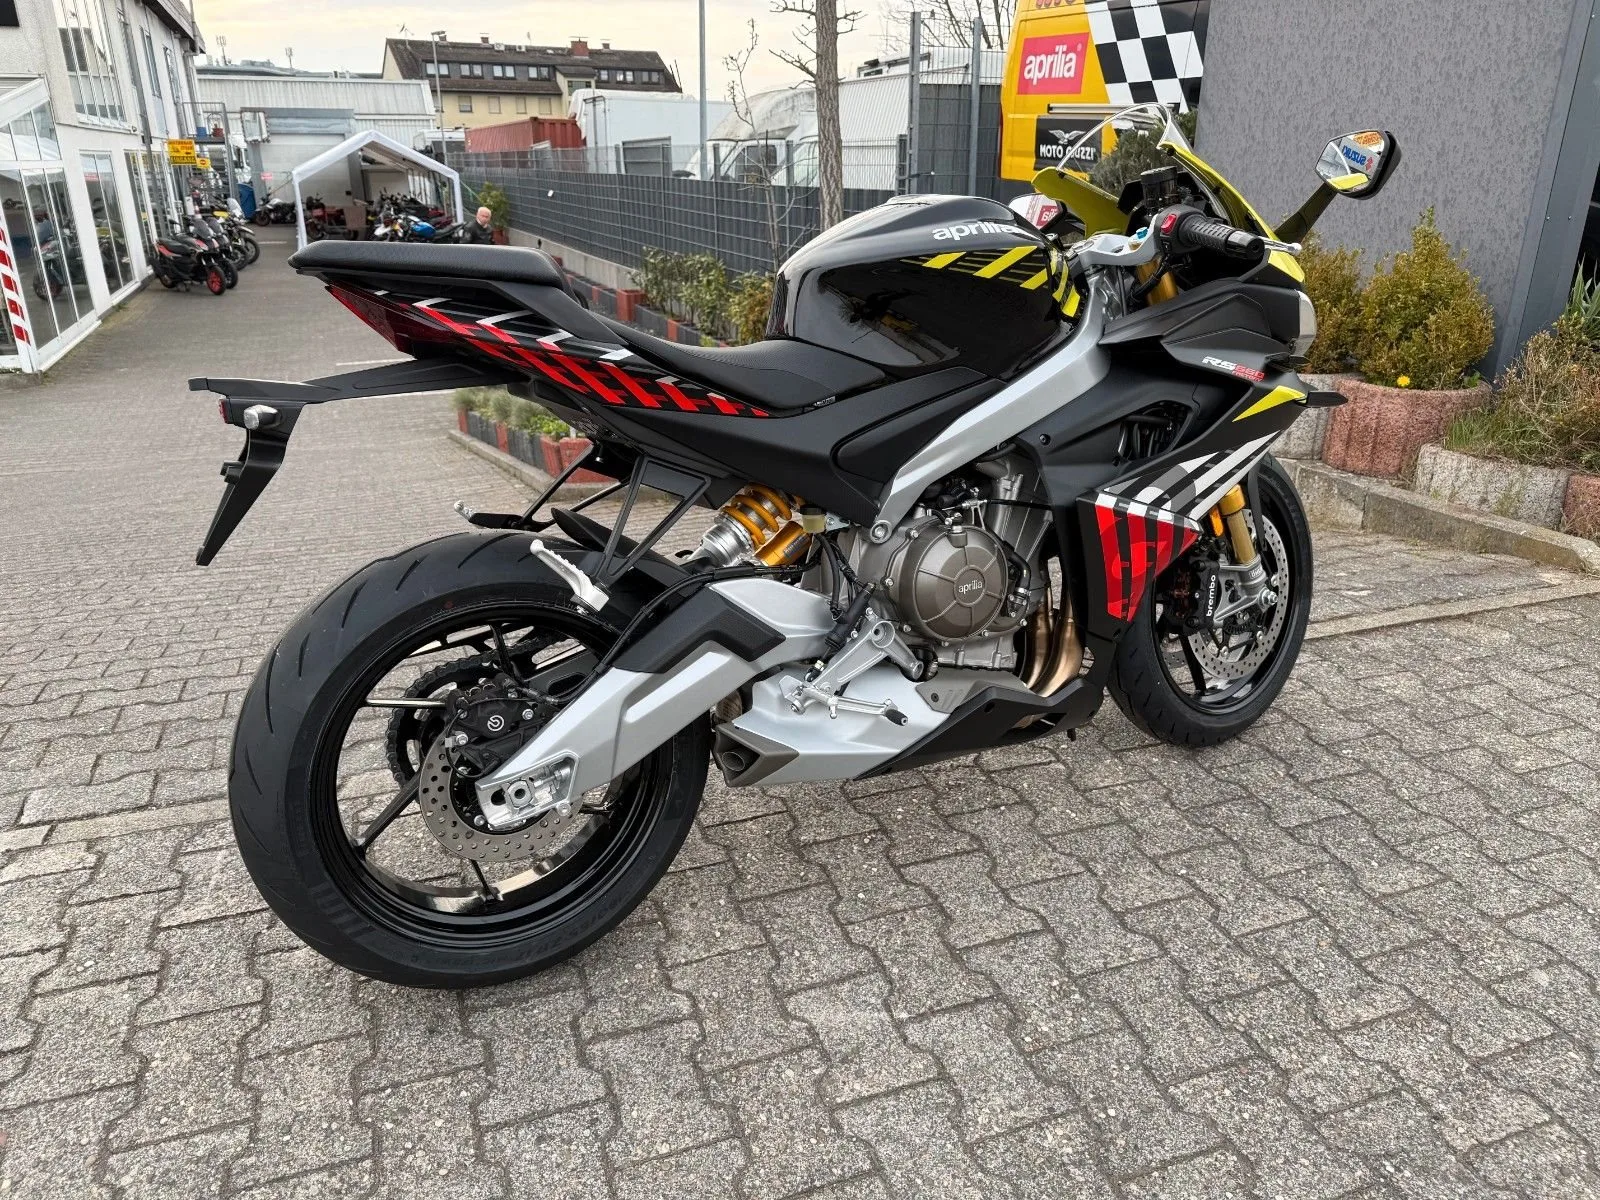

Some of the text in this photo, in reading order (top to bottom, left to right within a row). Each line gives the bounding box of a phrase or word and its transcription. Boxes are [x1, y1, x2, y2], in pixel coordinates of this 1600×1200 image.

[1023, 44, 1077, 86] aprilia
[1040, 144, 1063, 158] MOTO
[932, 221, 1019, 241] aprilia
[958, 580, 982, 594] aprilia
[1206, 574, 1216, 616] brembo
